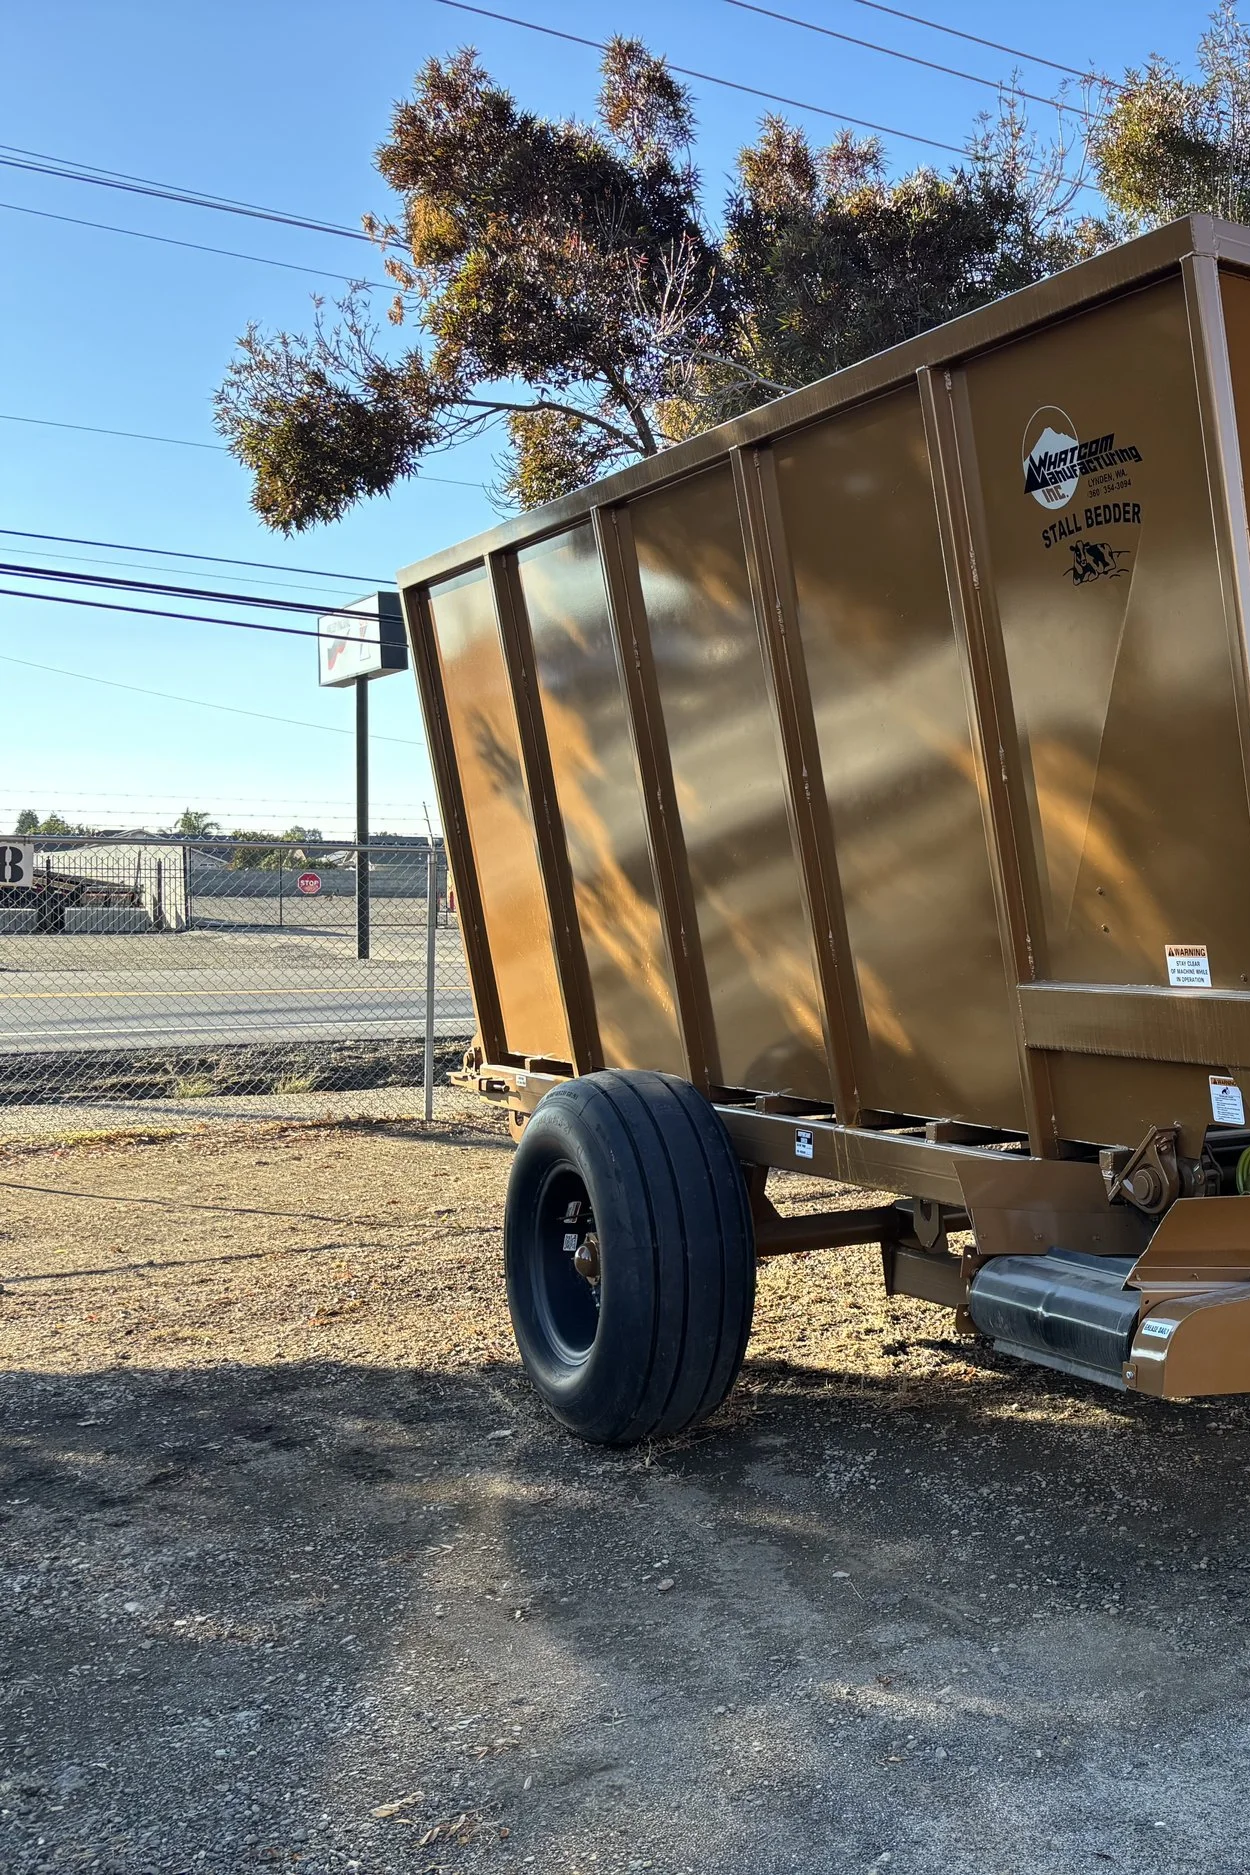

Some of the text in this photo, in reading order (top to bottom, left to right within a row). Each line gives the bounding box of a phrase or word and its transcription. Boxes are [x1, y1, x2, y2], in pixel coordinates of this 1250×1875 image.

[1088, 468, 1128, 488] LYNDEN, WA.
[1103, 478, 1132, 494] 354-3094
[1042, 485, 1069, 503] INC.
[1042, 502, 1141, 549] STALL BEDDER
[1173, 948, 1206, 957] WARNING
[1144, 1323, 1171, 1335] GREASE DAILY
